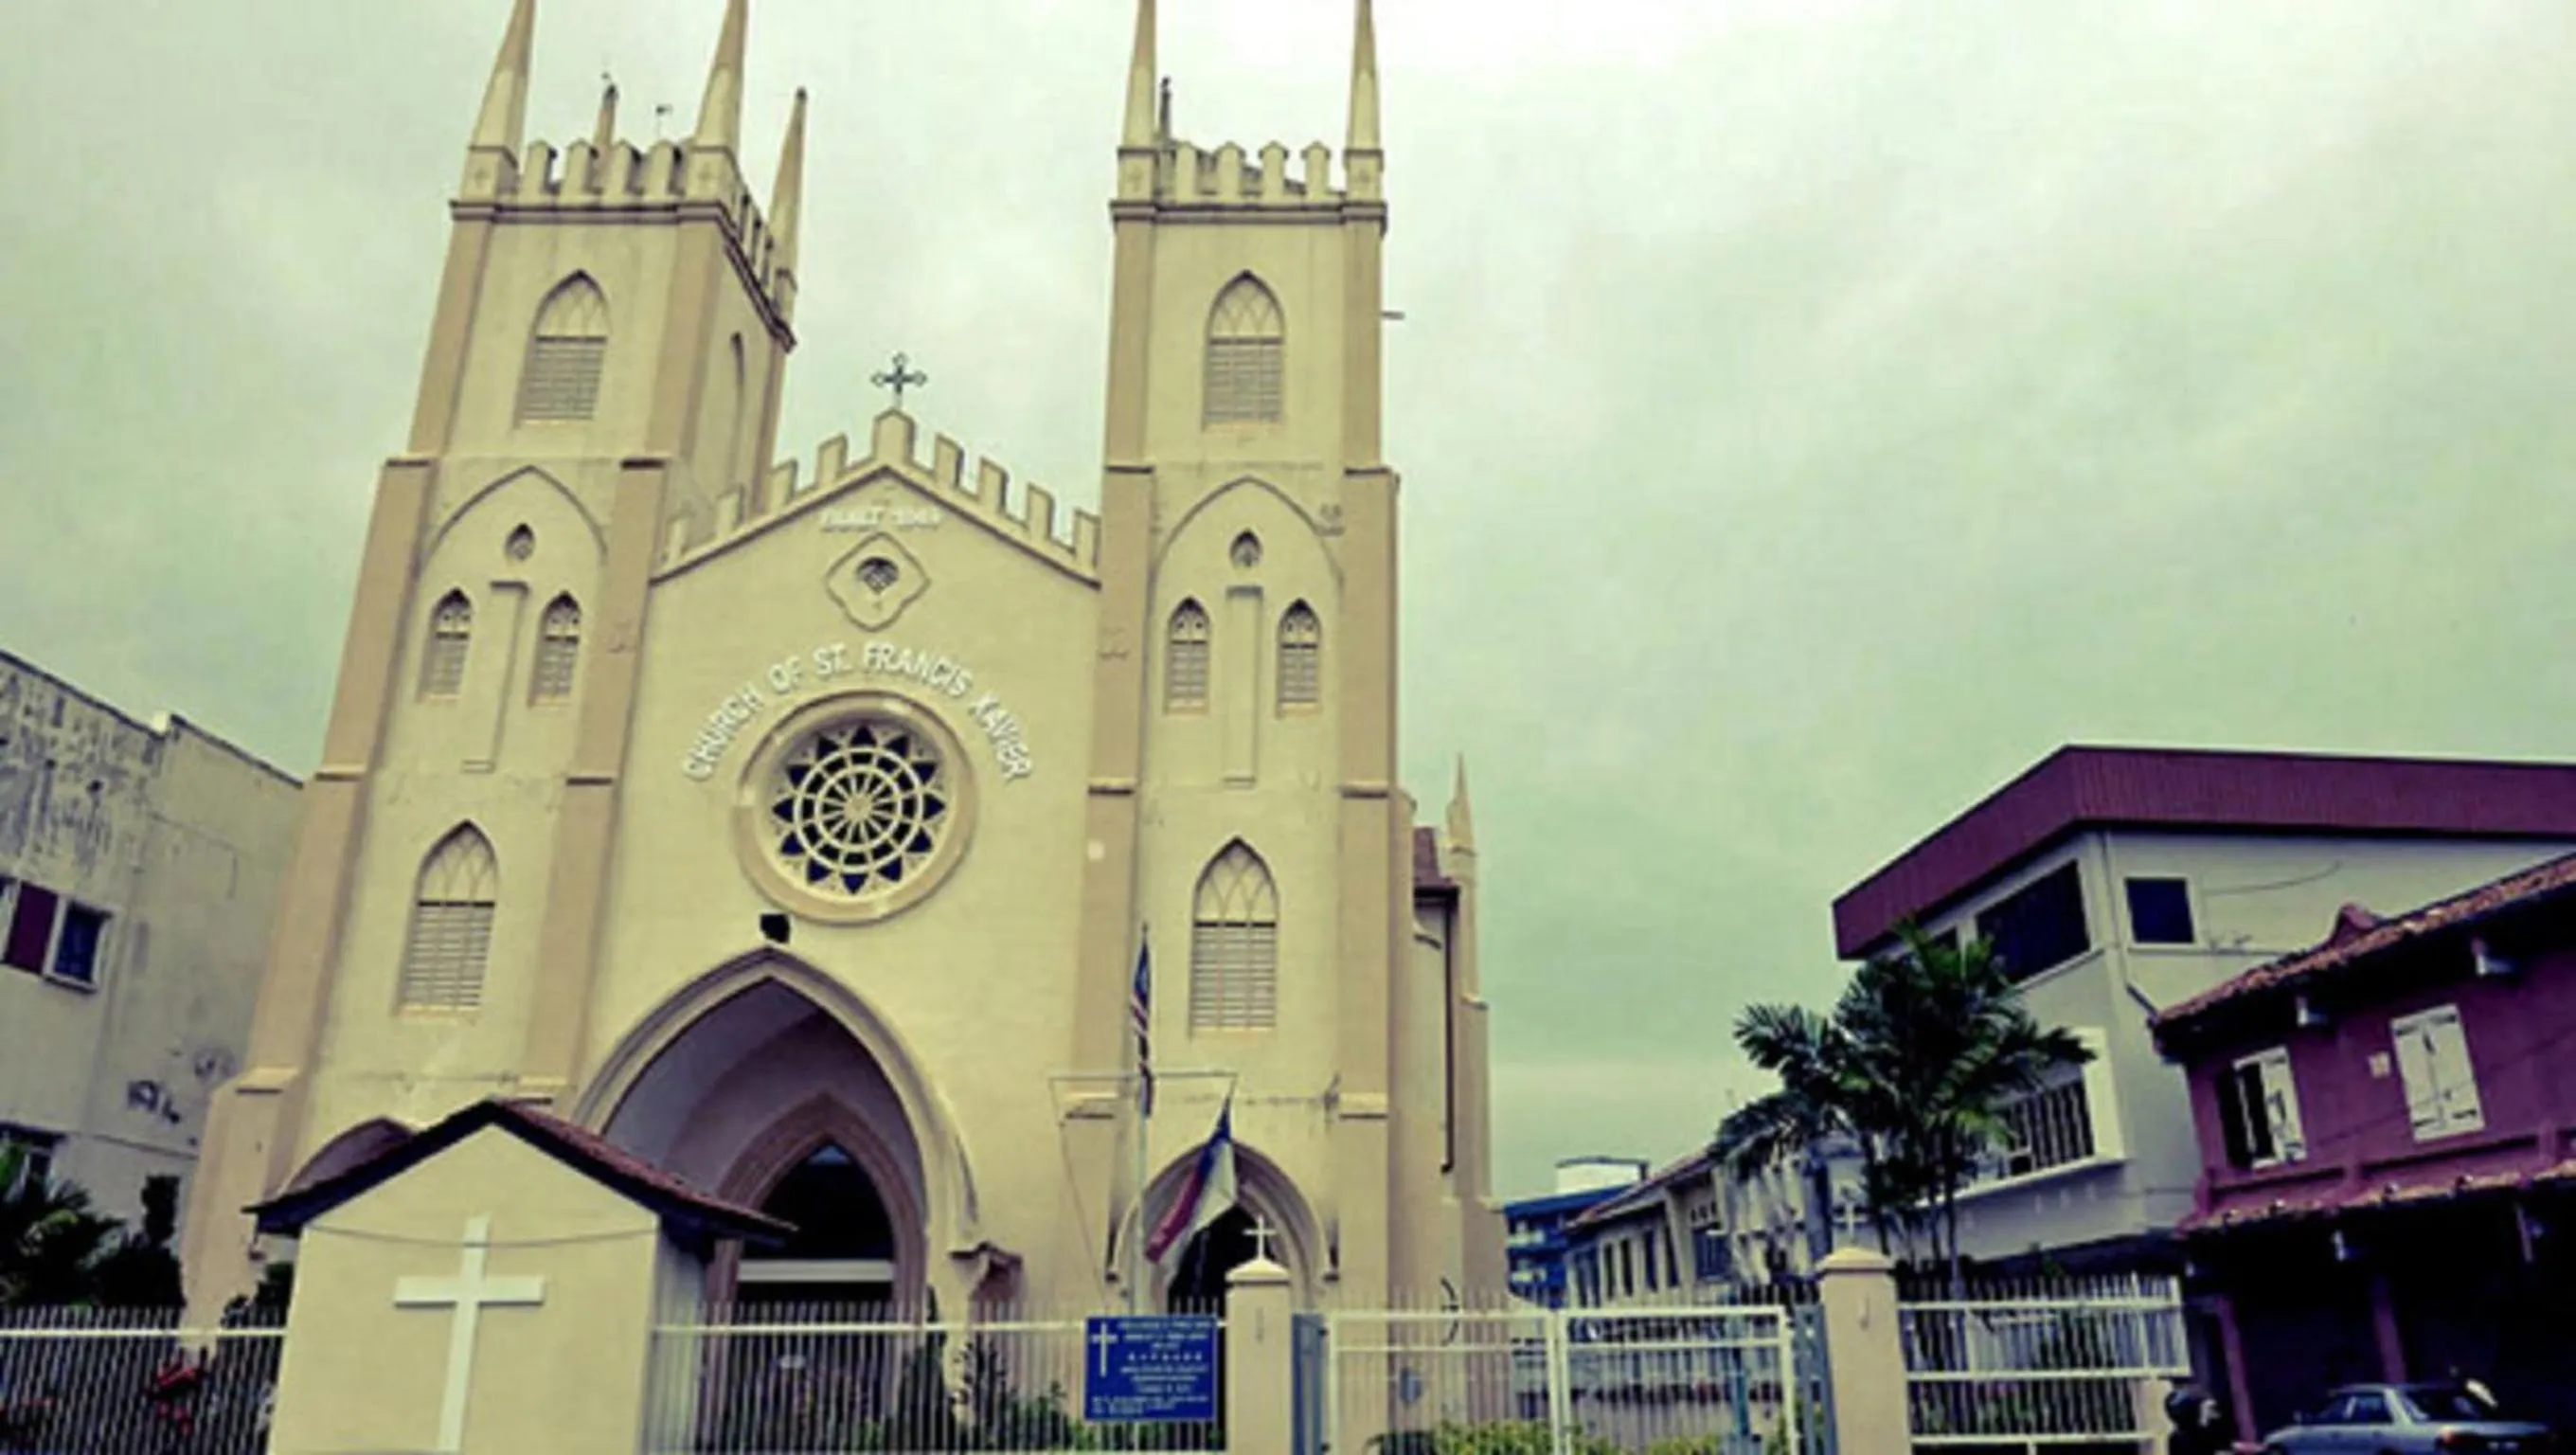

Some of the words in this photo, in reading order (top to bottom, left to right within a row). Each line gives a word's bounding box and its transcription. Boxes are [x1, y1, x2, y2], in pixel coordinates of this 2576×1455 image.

[682, 682, 762, 780] CHURCH
[768, 656, 800, 693] OF
[863, 640, 972, 696] FRANCIS
[968, 692, 1032, 780] XAVIER
